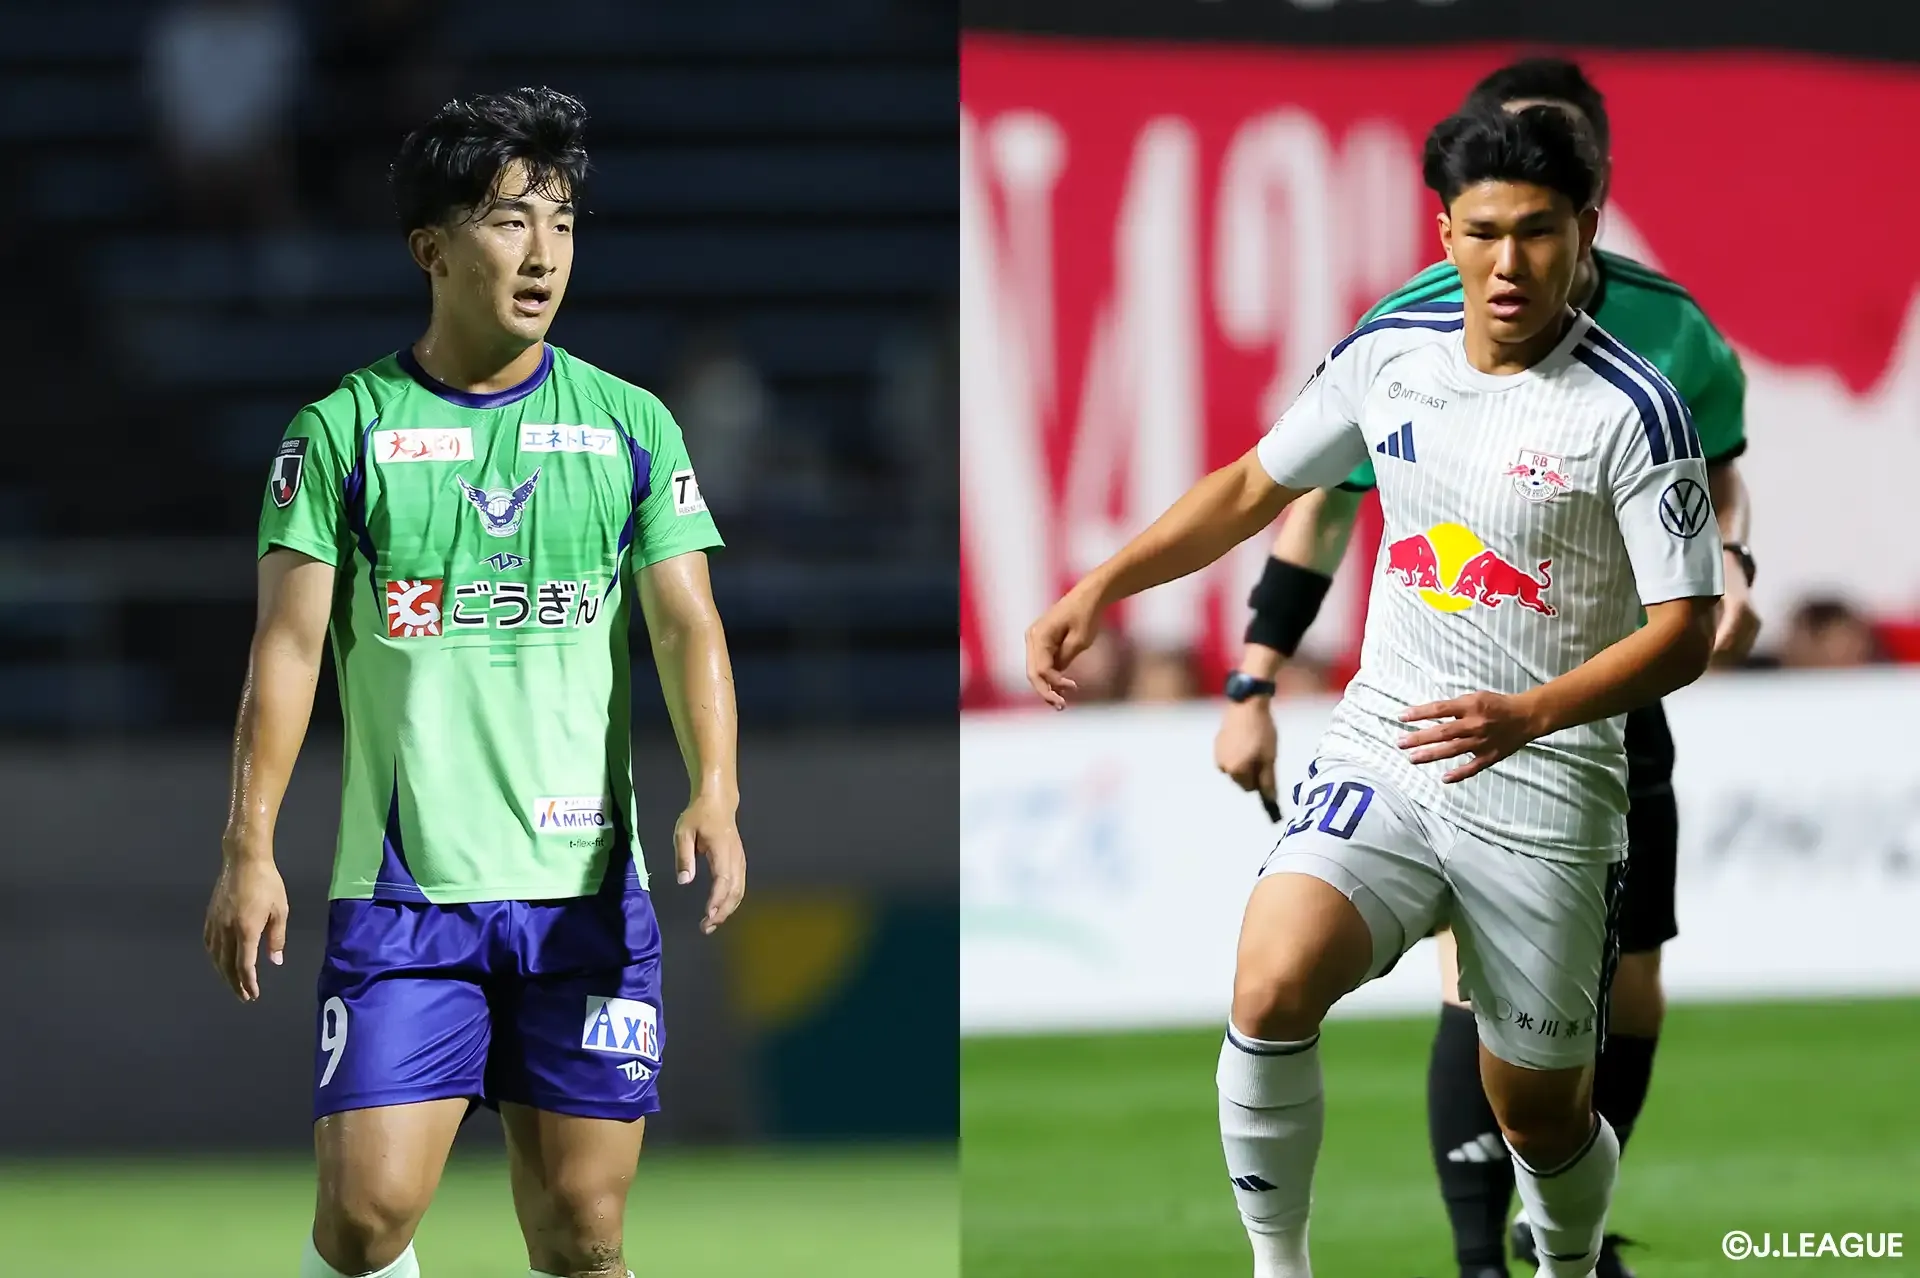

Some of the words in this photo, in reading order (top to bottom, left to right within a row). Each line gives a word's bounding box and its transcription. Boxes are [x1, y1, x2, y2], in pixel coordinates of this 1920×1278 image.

[1420, 394, 1448, 410] EAST
[388, 431, 460, 459] 大山り
[1532, 454, 1548, 468] RB
[452, 581, 600, 627] ごうぎん
[1285, 781, 1375, 840] 20
[319, 996, 348, 1088] 9
